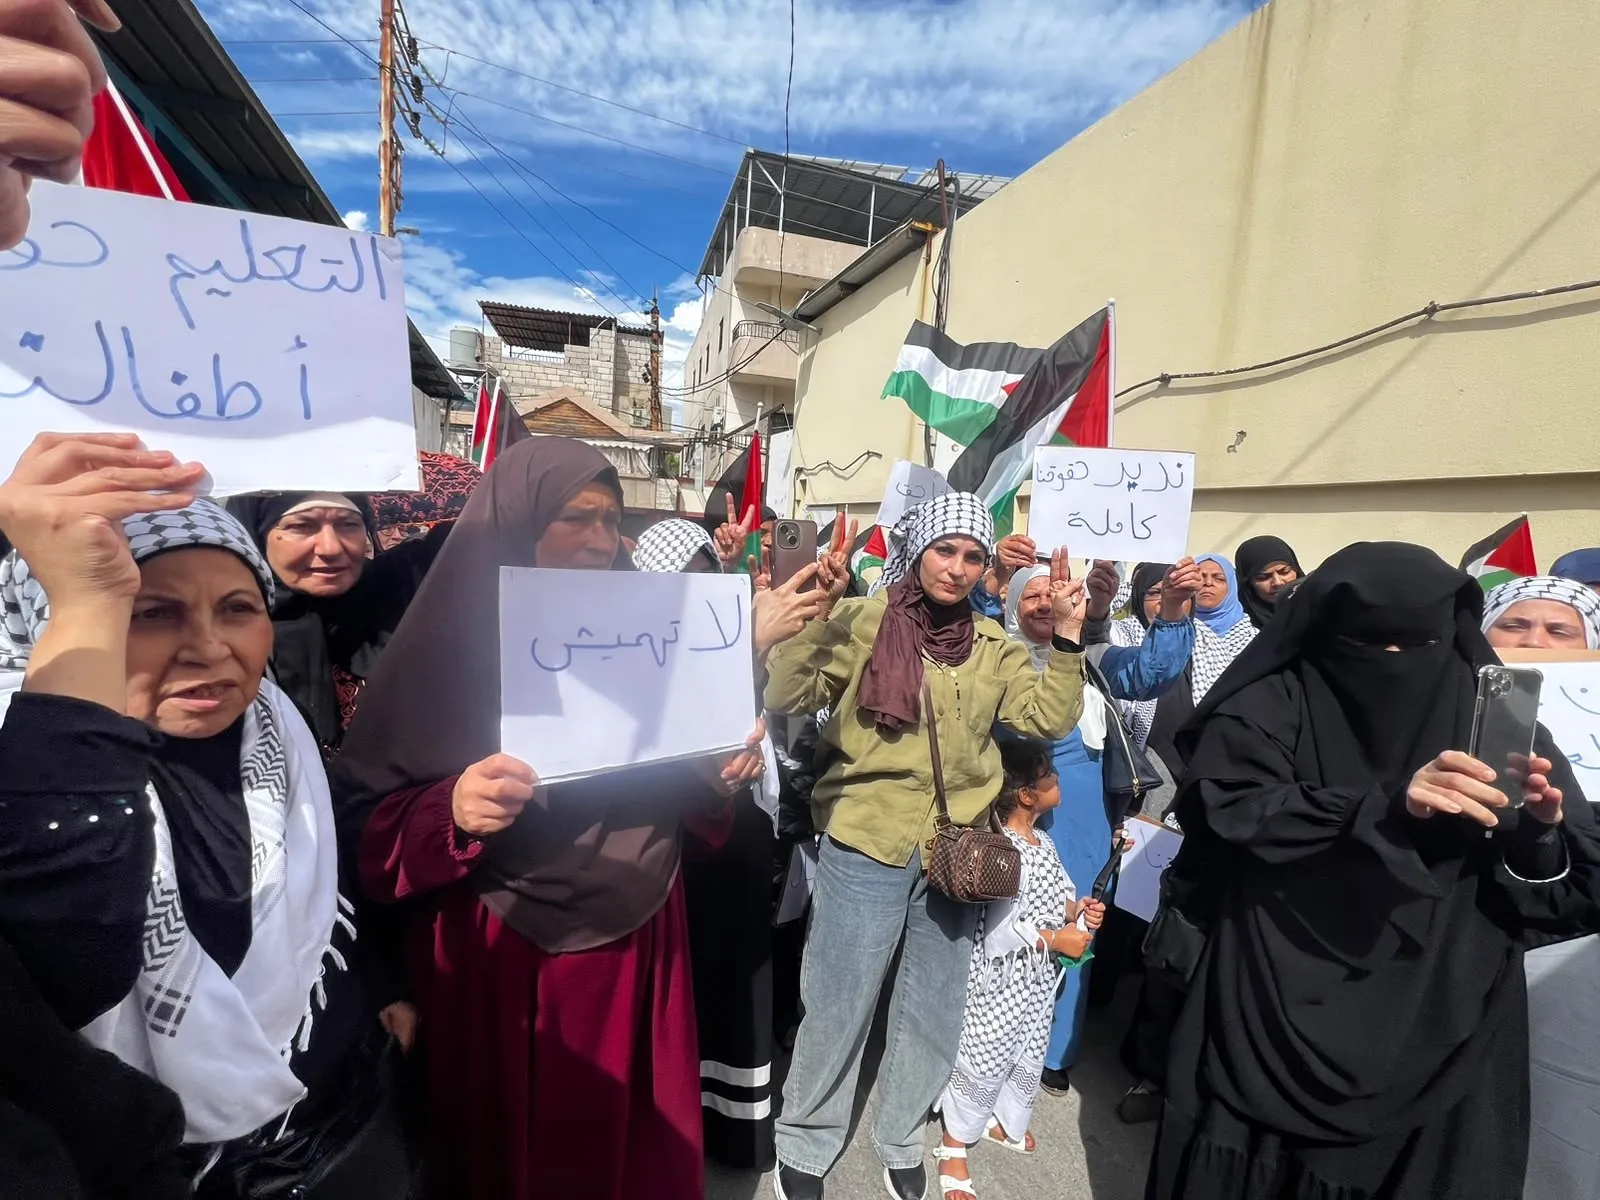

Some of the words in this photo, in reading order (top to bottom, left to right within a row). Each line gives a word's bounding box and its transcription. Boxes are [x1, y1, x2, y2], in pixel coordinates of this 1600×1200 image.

[165, 218, 387, 330] التعليم
[0, 319, 313, 421] أطفالن
[1067, 502, 1157, 540] كاملة
[688, 593, 742, 652] لا
